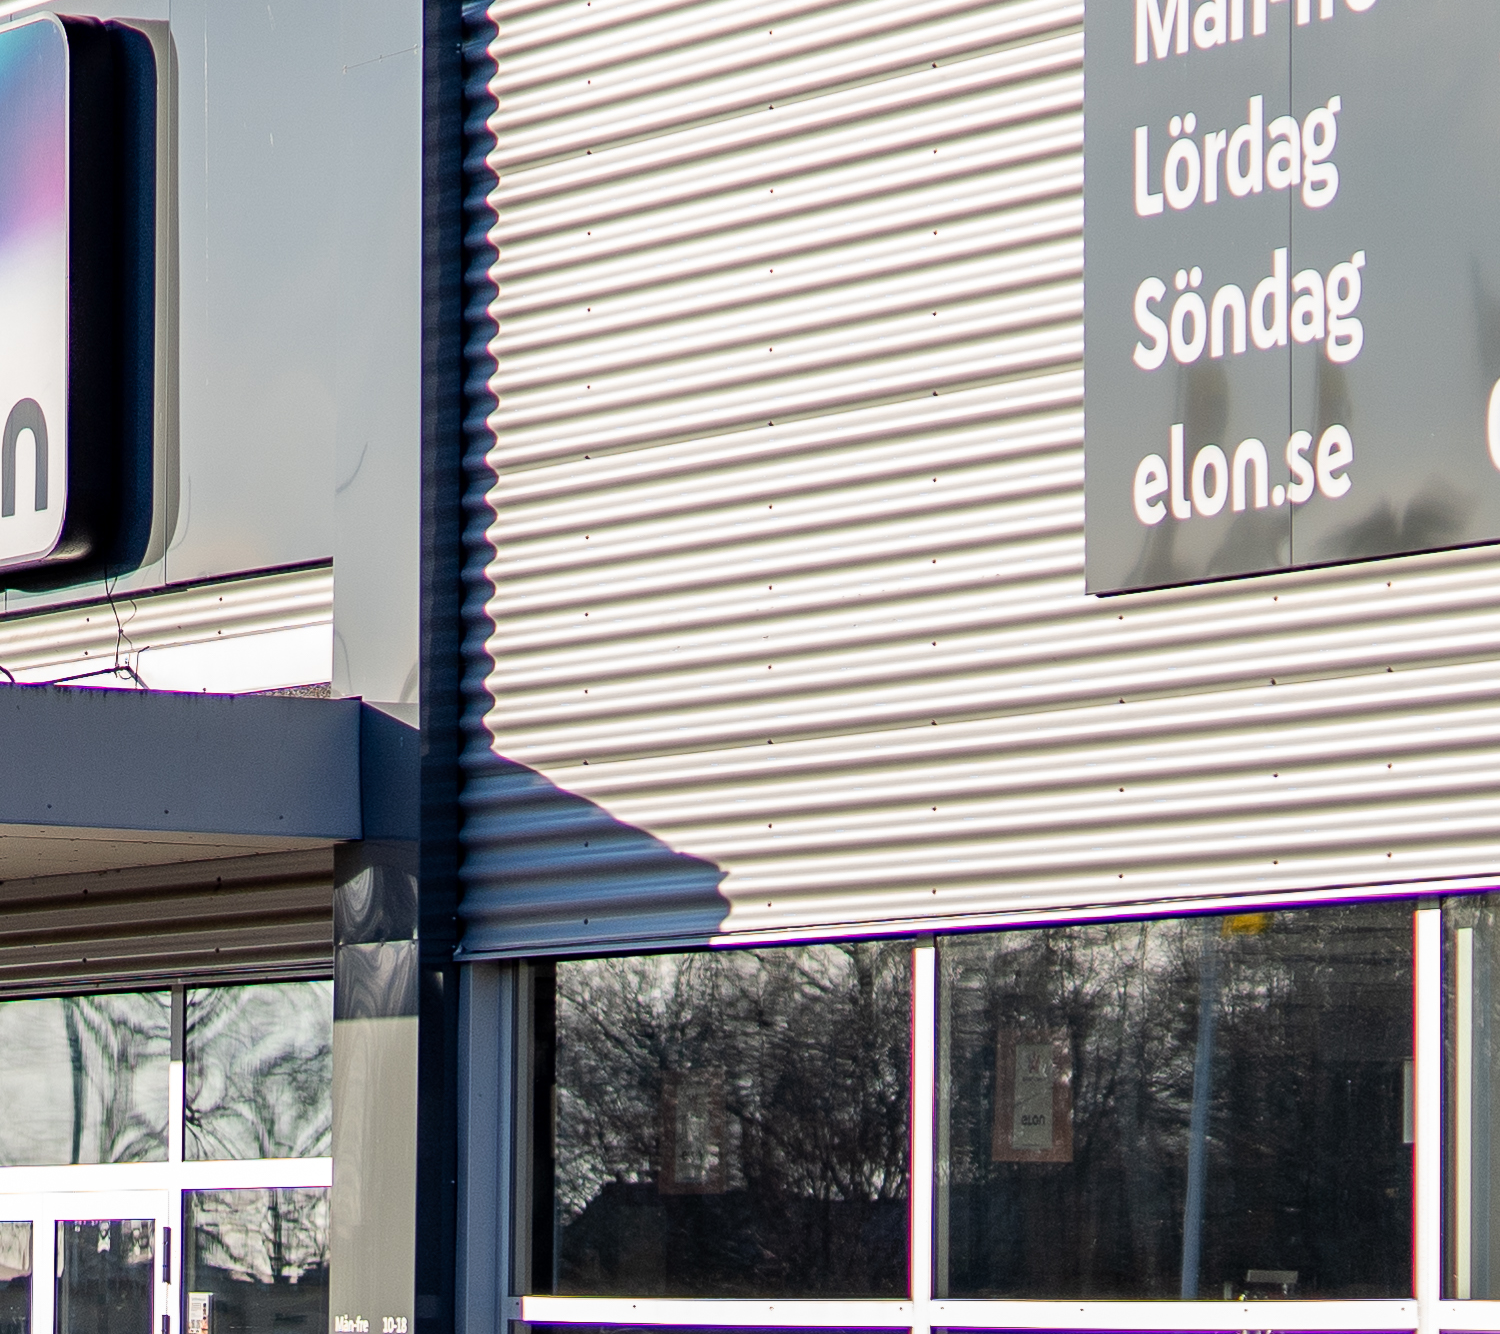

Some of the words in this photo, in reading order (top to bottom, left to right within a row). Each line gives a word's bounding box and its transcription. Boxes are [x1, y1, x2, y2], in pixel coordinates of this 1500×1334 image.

[1135, 94, 1342, 216] Lördag
[1133, 247, 1366, 369] Söndag
[1133, 422, 1354, 525] elon.se
[334, 1314, 369, 1333] Mån-fre
[382, 1316, 408, 1334] 10-18
